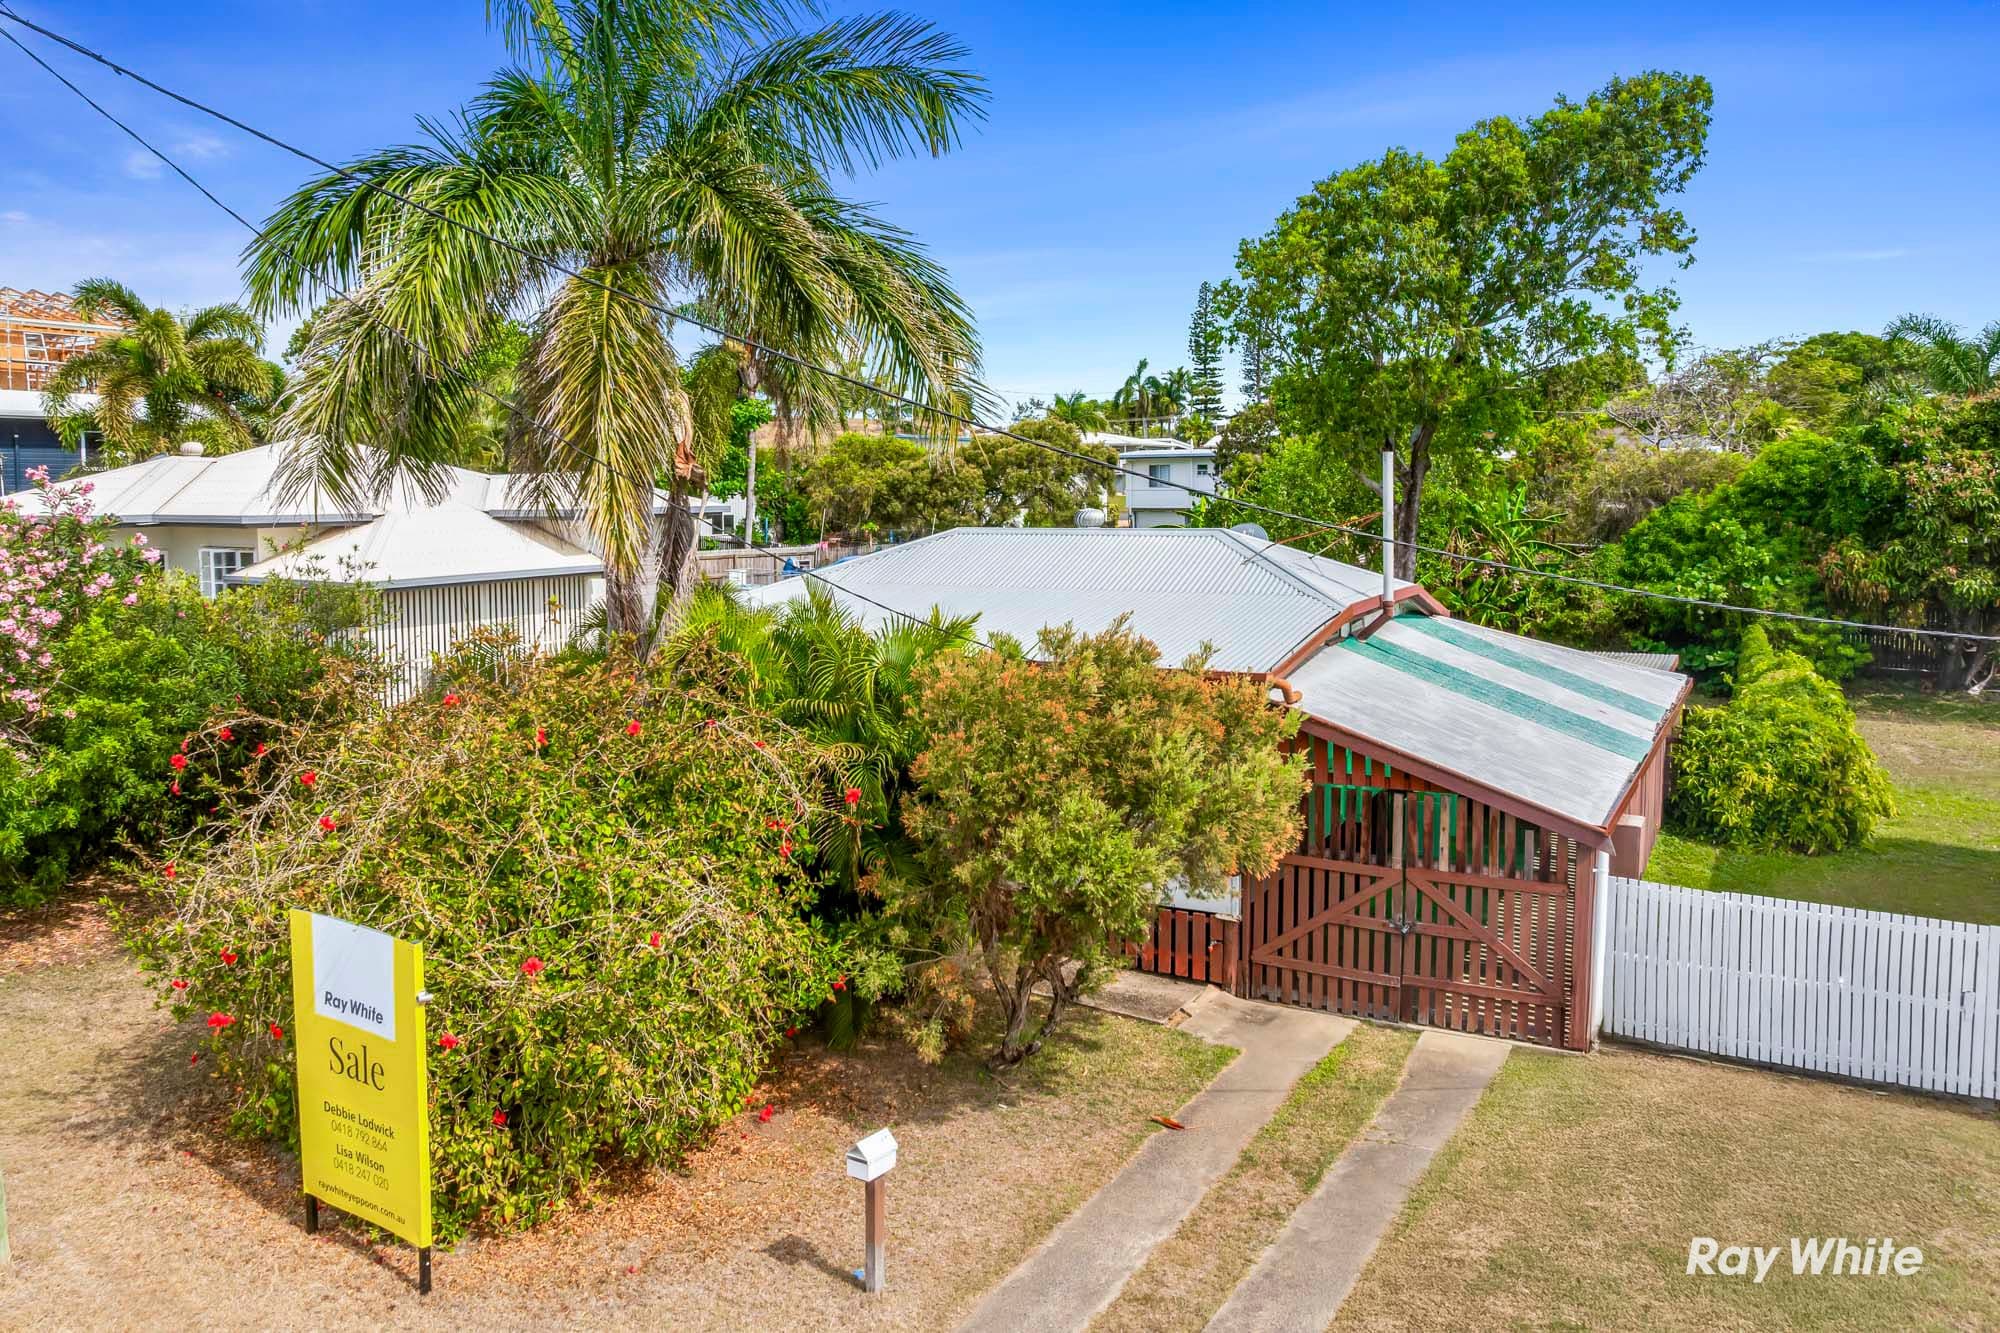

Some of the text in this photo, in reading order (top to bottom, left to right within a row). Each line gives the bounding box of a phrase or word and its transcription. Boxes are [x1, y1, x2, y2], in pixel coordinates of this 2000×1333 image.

[324, 991, 384, 1024] Ray White
[329, 1036, 385, 1091] Sale
[323, 1100, 395, 1139] Debbie Lodwick
[331, 1119, 353, 1138] 0418
[355, 1127, 370, 1146] 792
[333, 1157, 389, 1191] 0418 247 020
[336, 1143, 385, 1173] Lisa Wilson
[318, 1180, 406, 1225] raywhiteyeppoon.com.au
